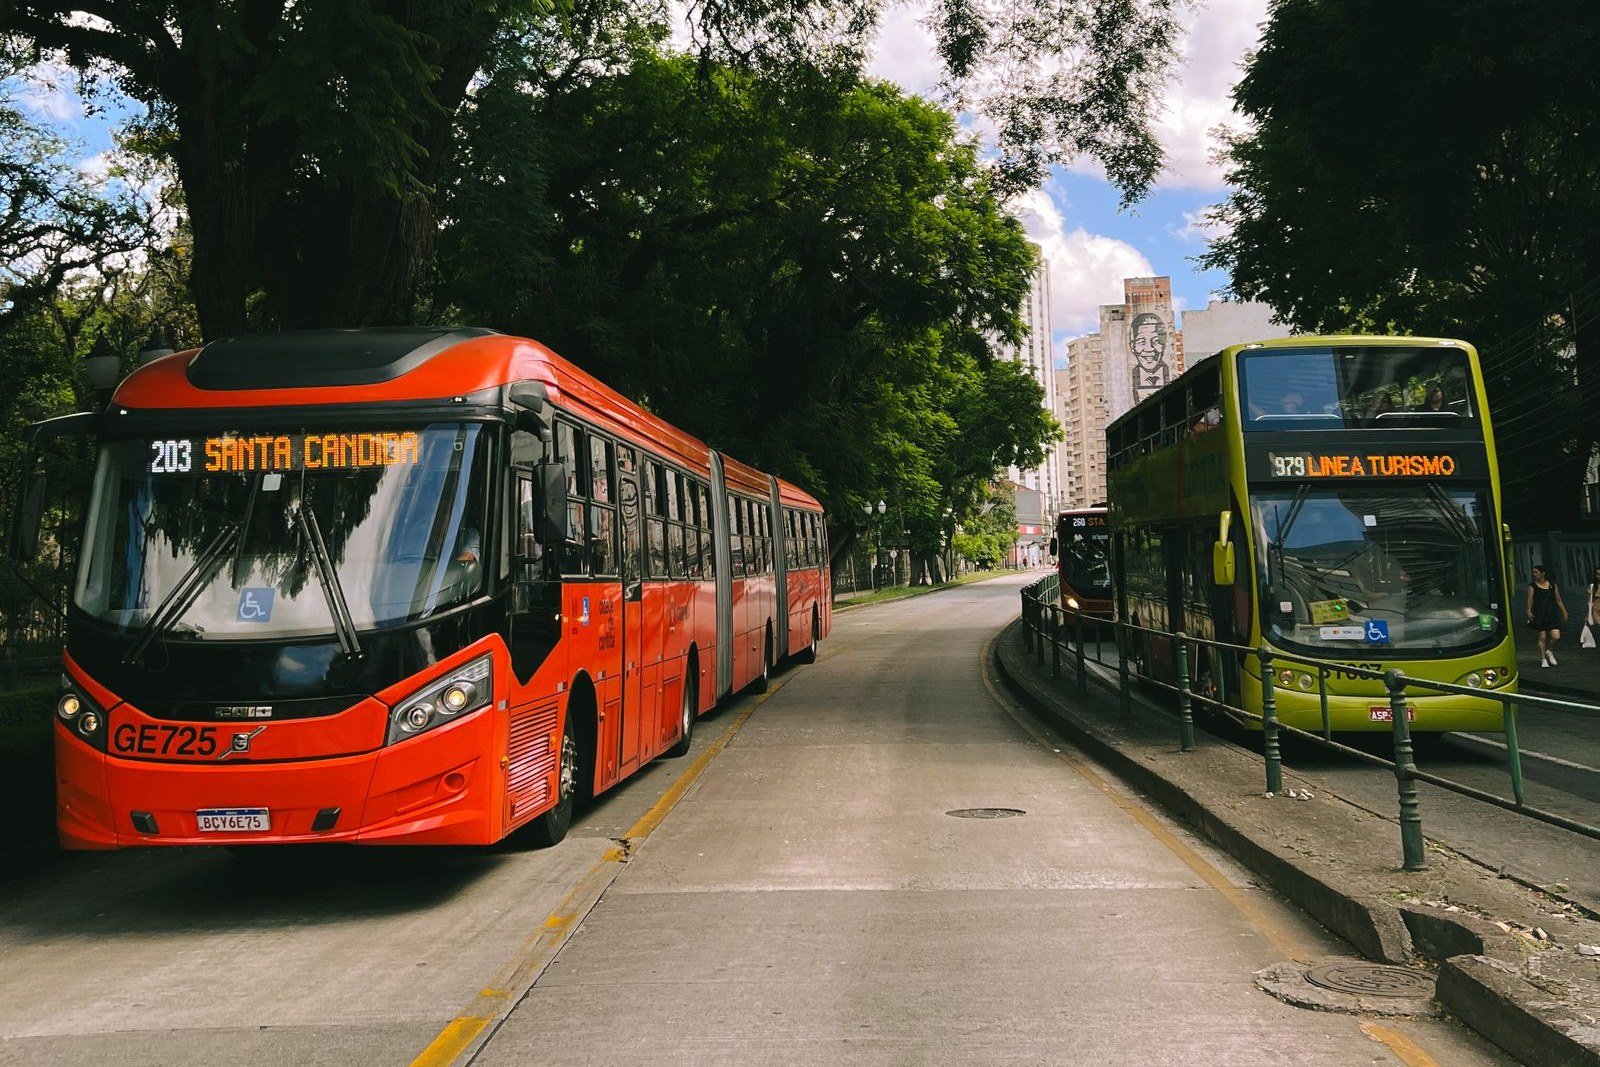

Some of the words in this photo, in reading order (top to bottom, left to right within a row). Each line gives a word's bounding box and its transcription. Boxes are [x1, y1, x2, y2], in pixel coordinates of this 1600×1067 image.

[151, 440, 192, 472] 203
[205, 436, 291, 471] SANTA
[1274, 456, 1305, 476] 979
[1307, 456, 1366, 477] LINEA
[1367, 455, 1456, 476] TURISMO
[1073, 517, 1086, 527] 260
[113, 723, 217, 756] GE725
[203, 816, 261, 829] BCY6E75
